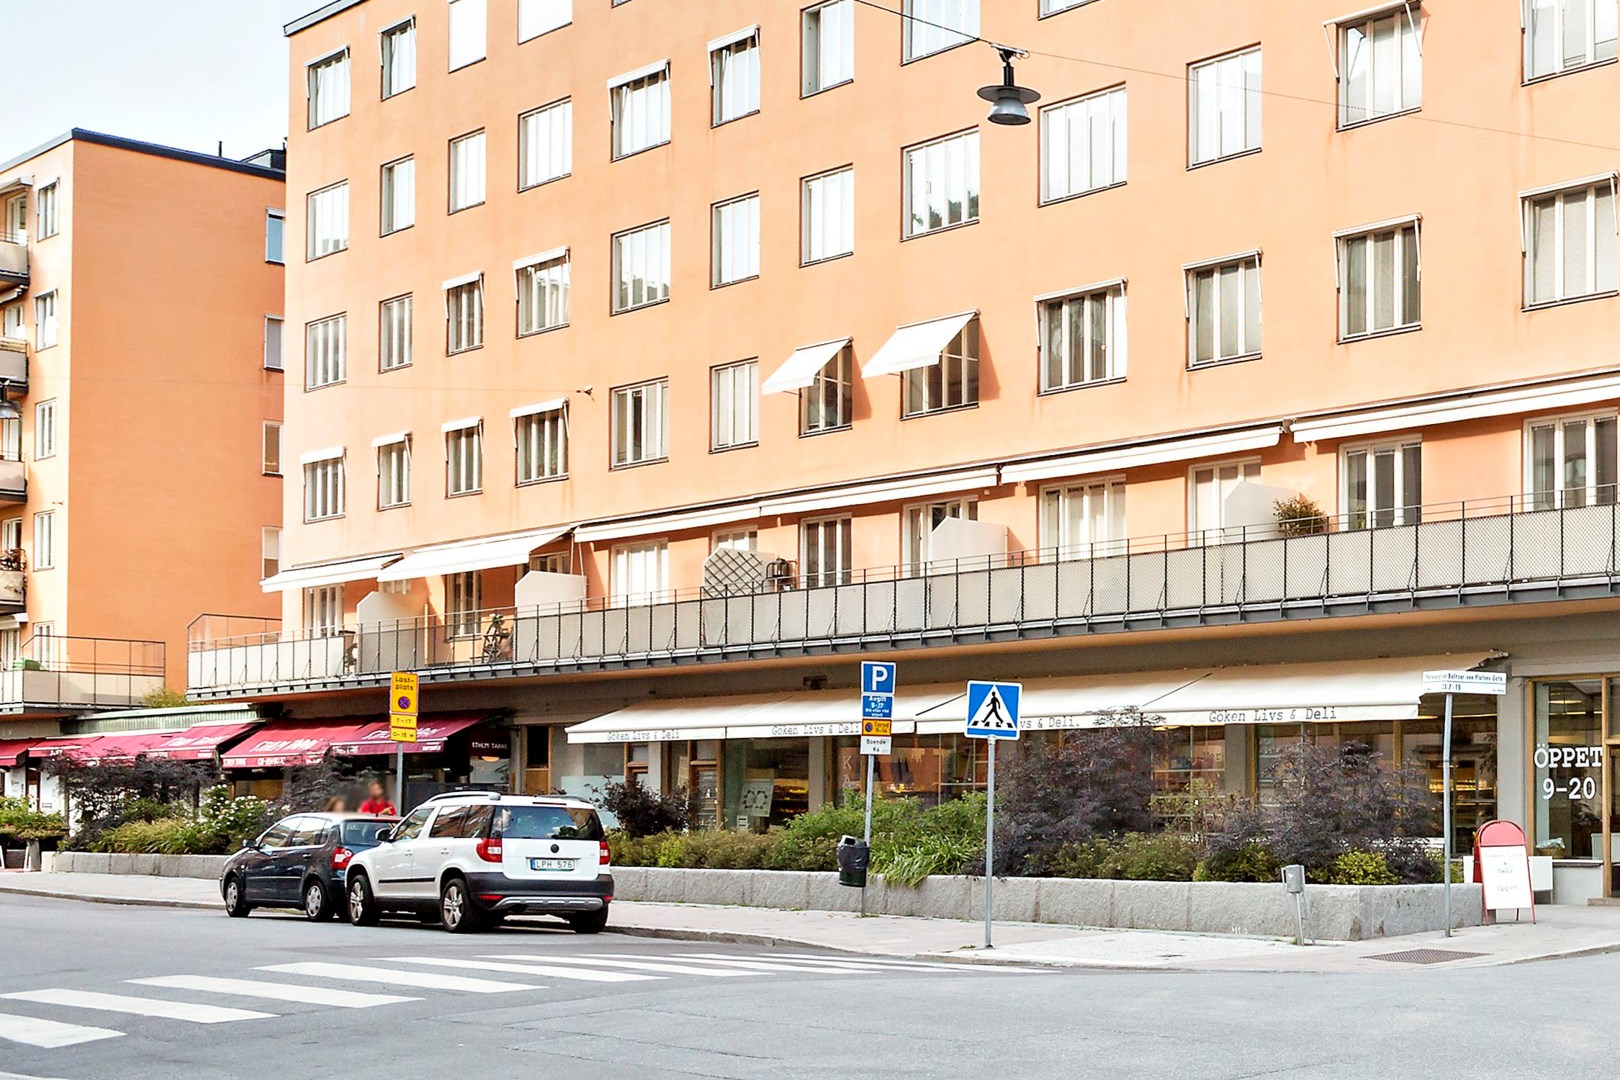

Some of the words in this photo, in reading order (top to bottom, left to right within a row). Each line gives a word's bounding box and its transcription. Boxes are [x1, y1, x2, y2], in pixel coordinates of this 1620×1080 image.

[872, 665, 888, 691] P
[1254, 708, 1283, 721] Livs
[1306, 706, 1337, 720] Deli
[633, 730, 650, 740] Livs
[661, 728, 680, 739] Deli
[804, 723, 824, 734] Livs
[838, 722, 860, 734] Deli
[1534, 743, 1603, 769] ÖPPET
[1542, 777, 1596, 800] 9-20
